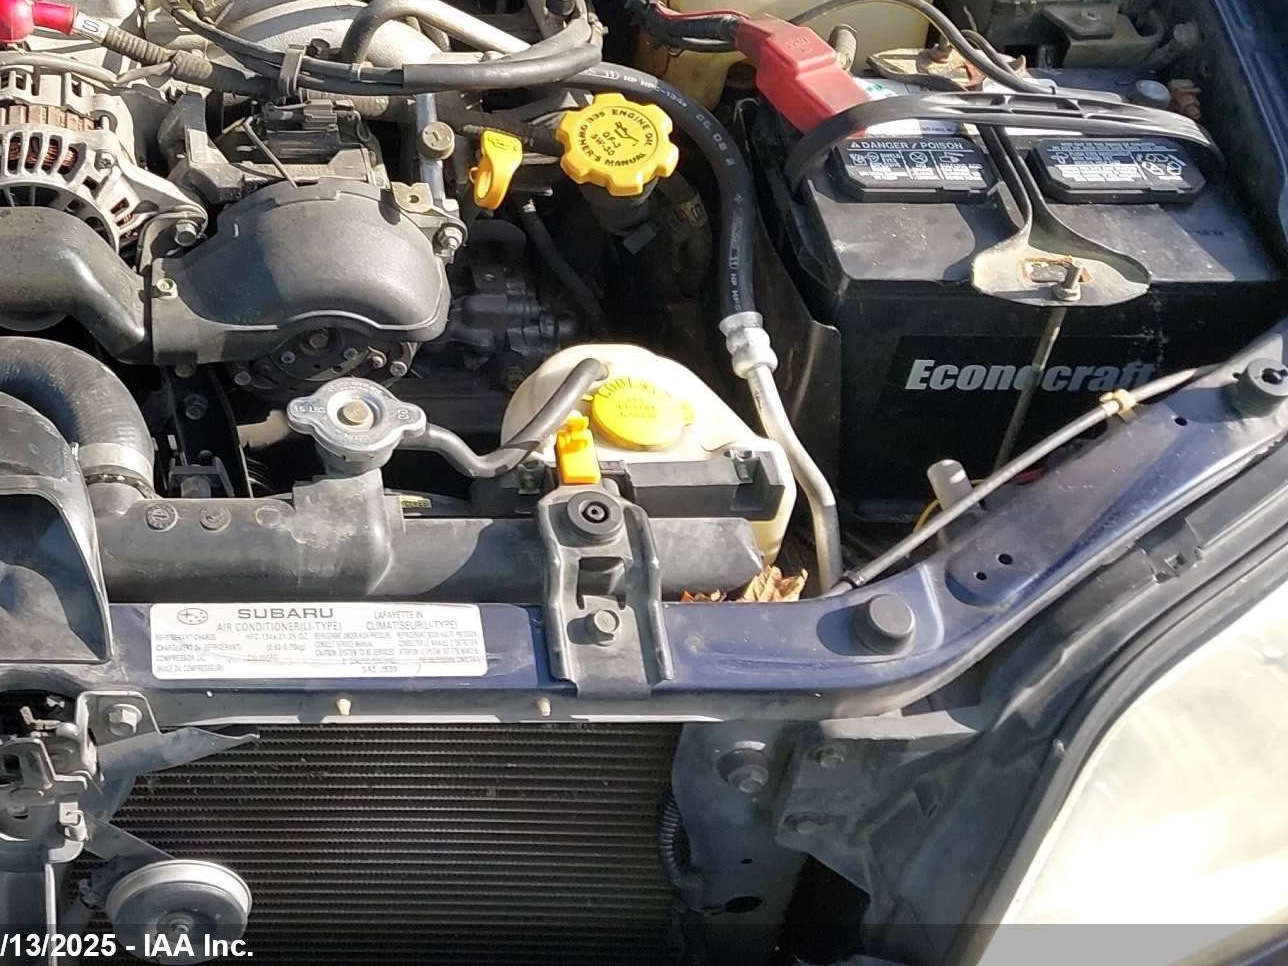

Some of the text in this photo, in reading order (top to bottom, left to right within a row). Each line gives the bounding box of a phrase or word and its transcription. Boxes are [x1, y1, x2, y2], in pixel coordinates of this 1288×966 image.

[611, 108, 653, 147] ENGINE OIL
[861, 141, 910, 149] DANGER
[920, 141, 964, 150] POISON
[604, 152, 647, 167] MANUAL
[237, 607, 334, 620] SUBARU
[216, 622, 232, 632] AIR
